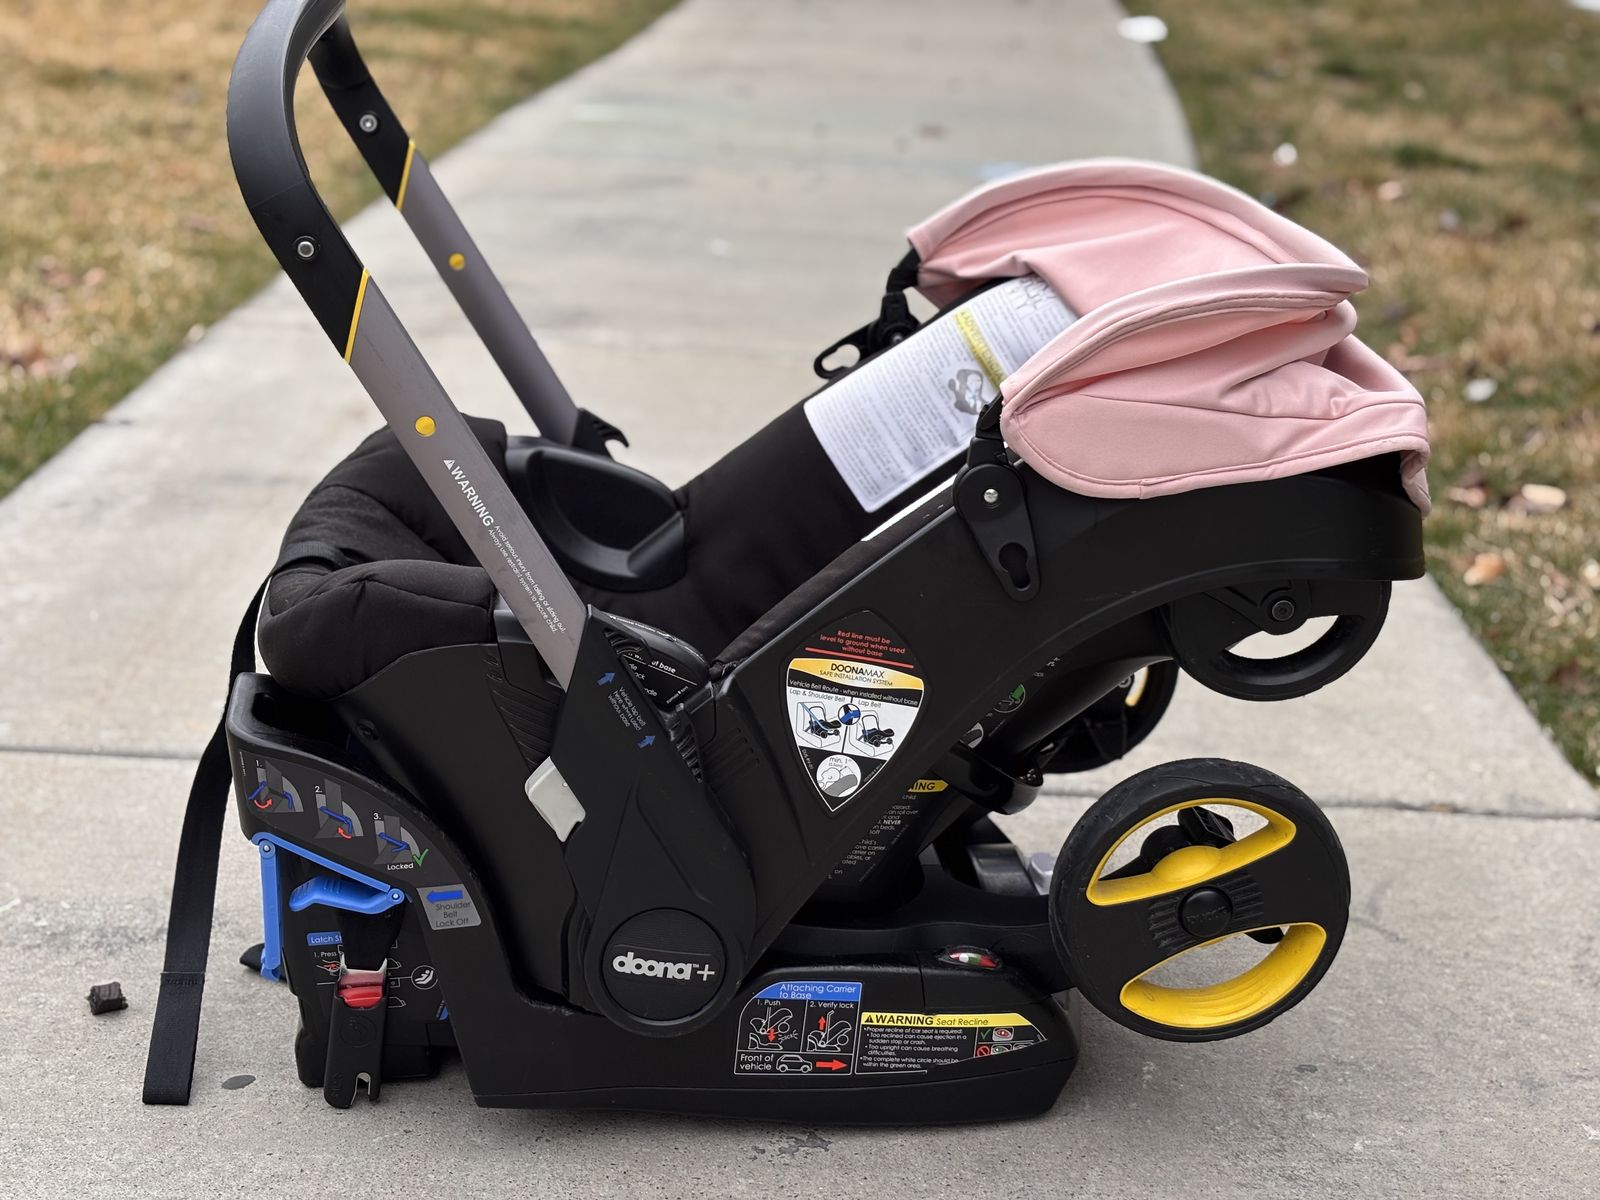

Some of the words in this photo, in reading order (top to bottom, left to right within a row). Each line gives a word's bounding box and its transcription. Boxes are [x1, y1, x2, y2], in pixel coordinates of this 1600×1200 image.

[451, 466, 494, 526] WARNING
[494, 525, 507, 541] Avoid
[842, 646, 866, 654] without
[845, 640, 869, 648] ground
[870, 643, 889, 651] when
[660, 662, 676, 673] base
[830, 663, 885, 679] DOONAMAX
[834, 672, 872, 683] INSTALLATION
[789, 679, 810, 688] Vehicle
[860, 691, 882, 700] installed
[882, 695, 903, 703] without
[808, 691, 833, 700] Shoulder
[436, 902, 471, 912] Shoulder
[436, 919, 453, 928] Lock
[780, 984, 824, 993] Attaching
[826, 984, 856, 993] Carrier
[876, 1015, 934, 1025] WARNING
